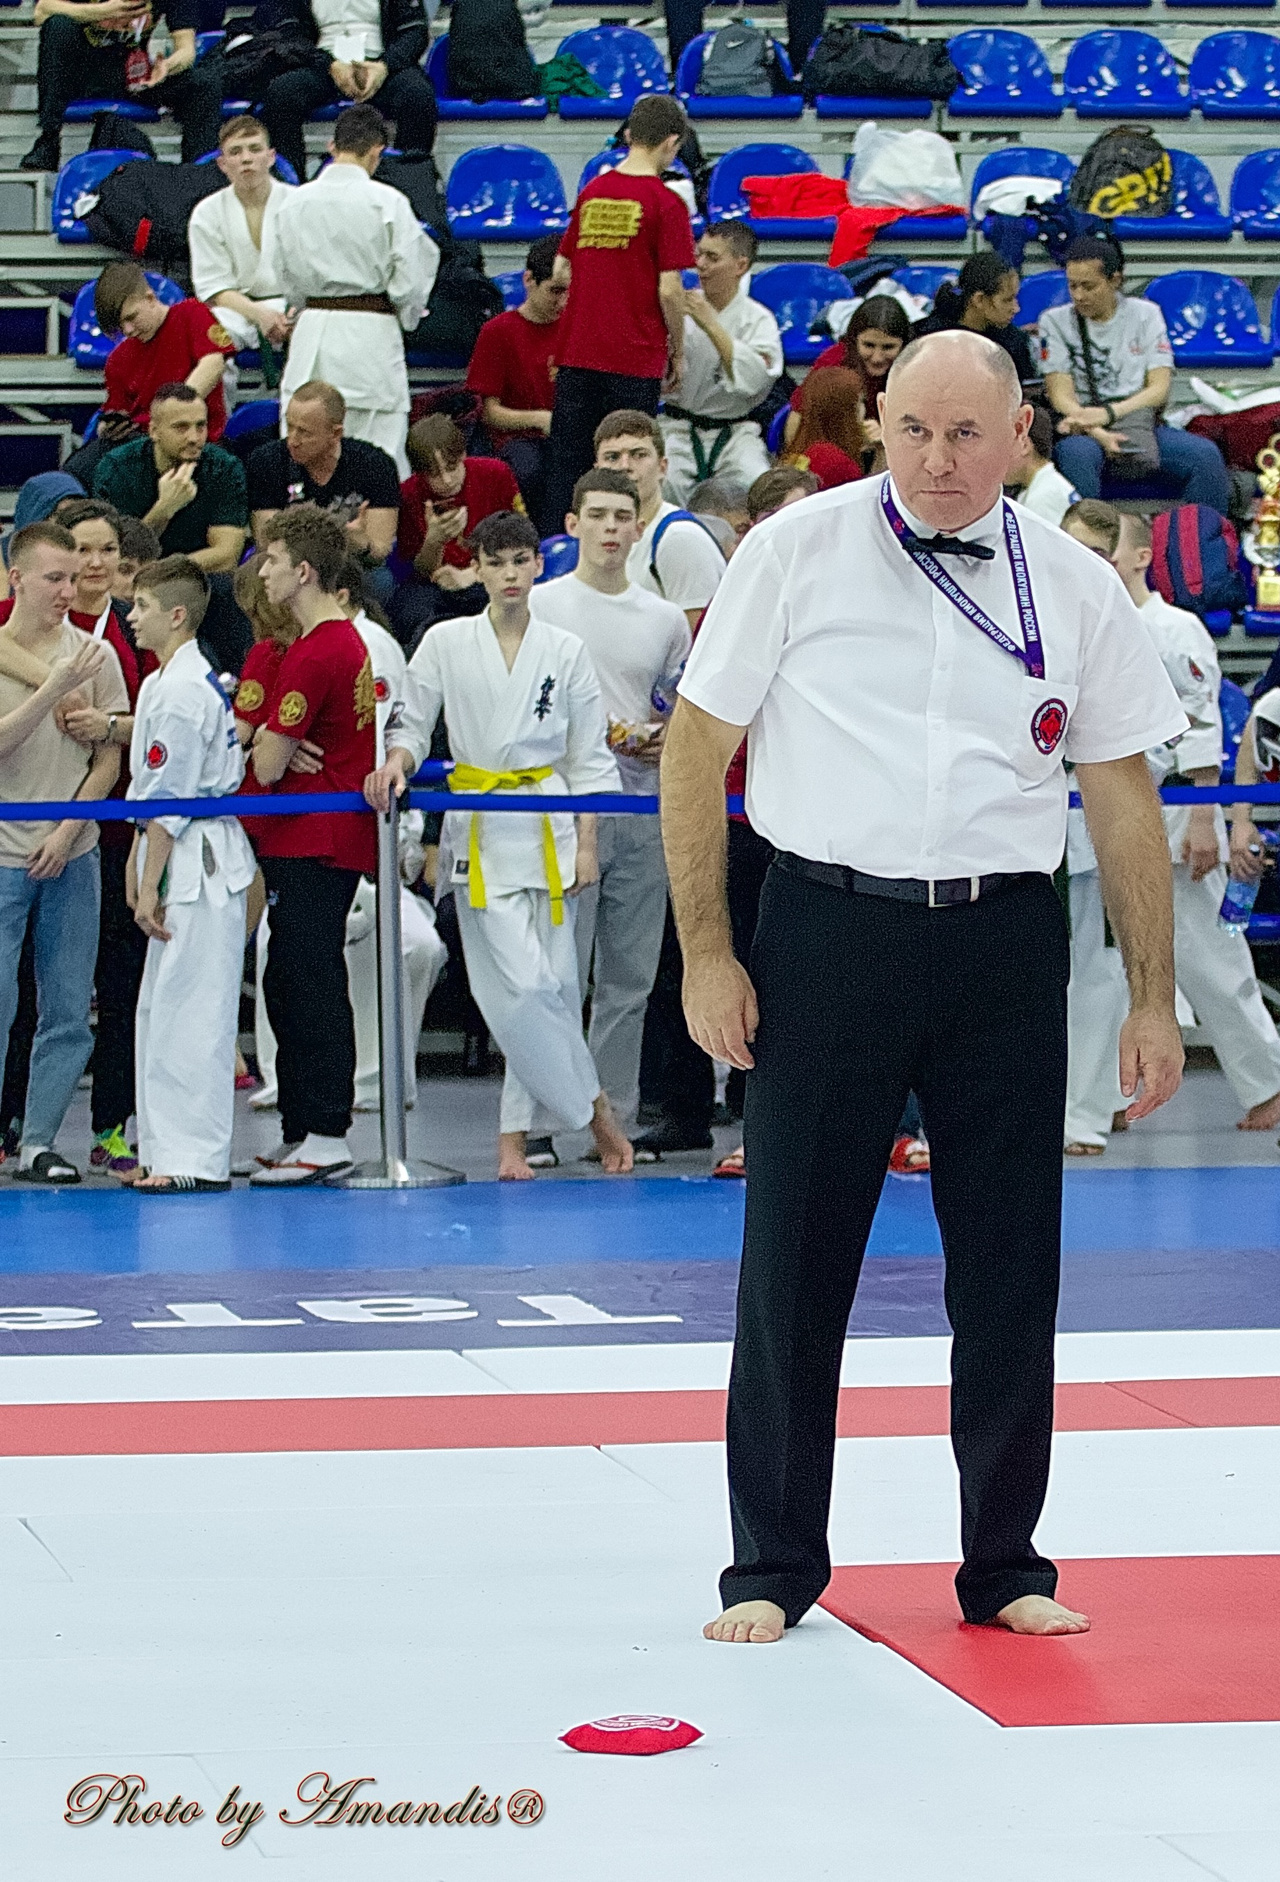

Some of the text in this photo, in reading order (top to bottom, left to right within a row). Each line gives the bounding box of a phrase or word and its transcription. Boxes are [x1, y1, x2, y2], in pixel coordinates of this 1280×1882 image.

[937, 574, 978, 617] КИОКУШИН
[1004, 511, 1038, 643] ФЕДЕРАЦИЯ КИОКУШИН РОССИИ
[973, 611, 1017, 652] ФЕДЕРАЦИЯ
